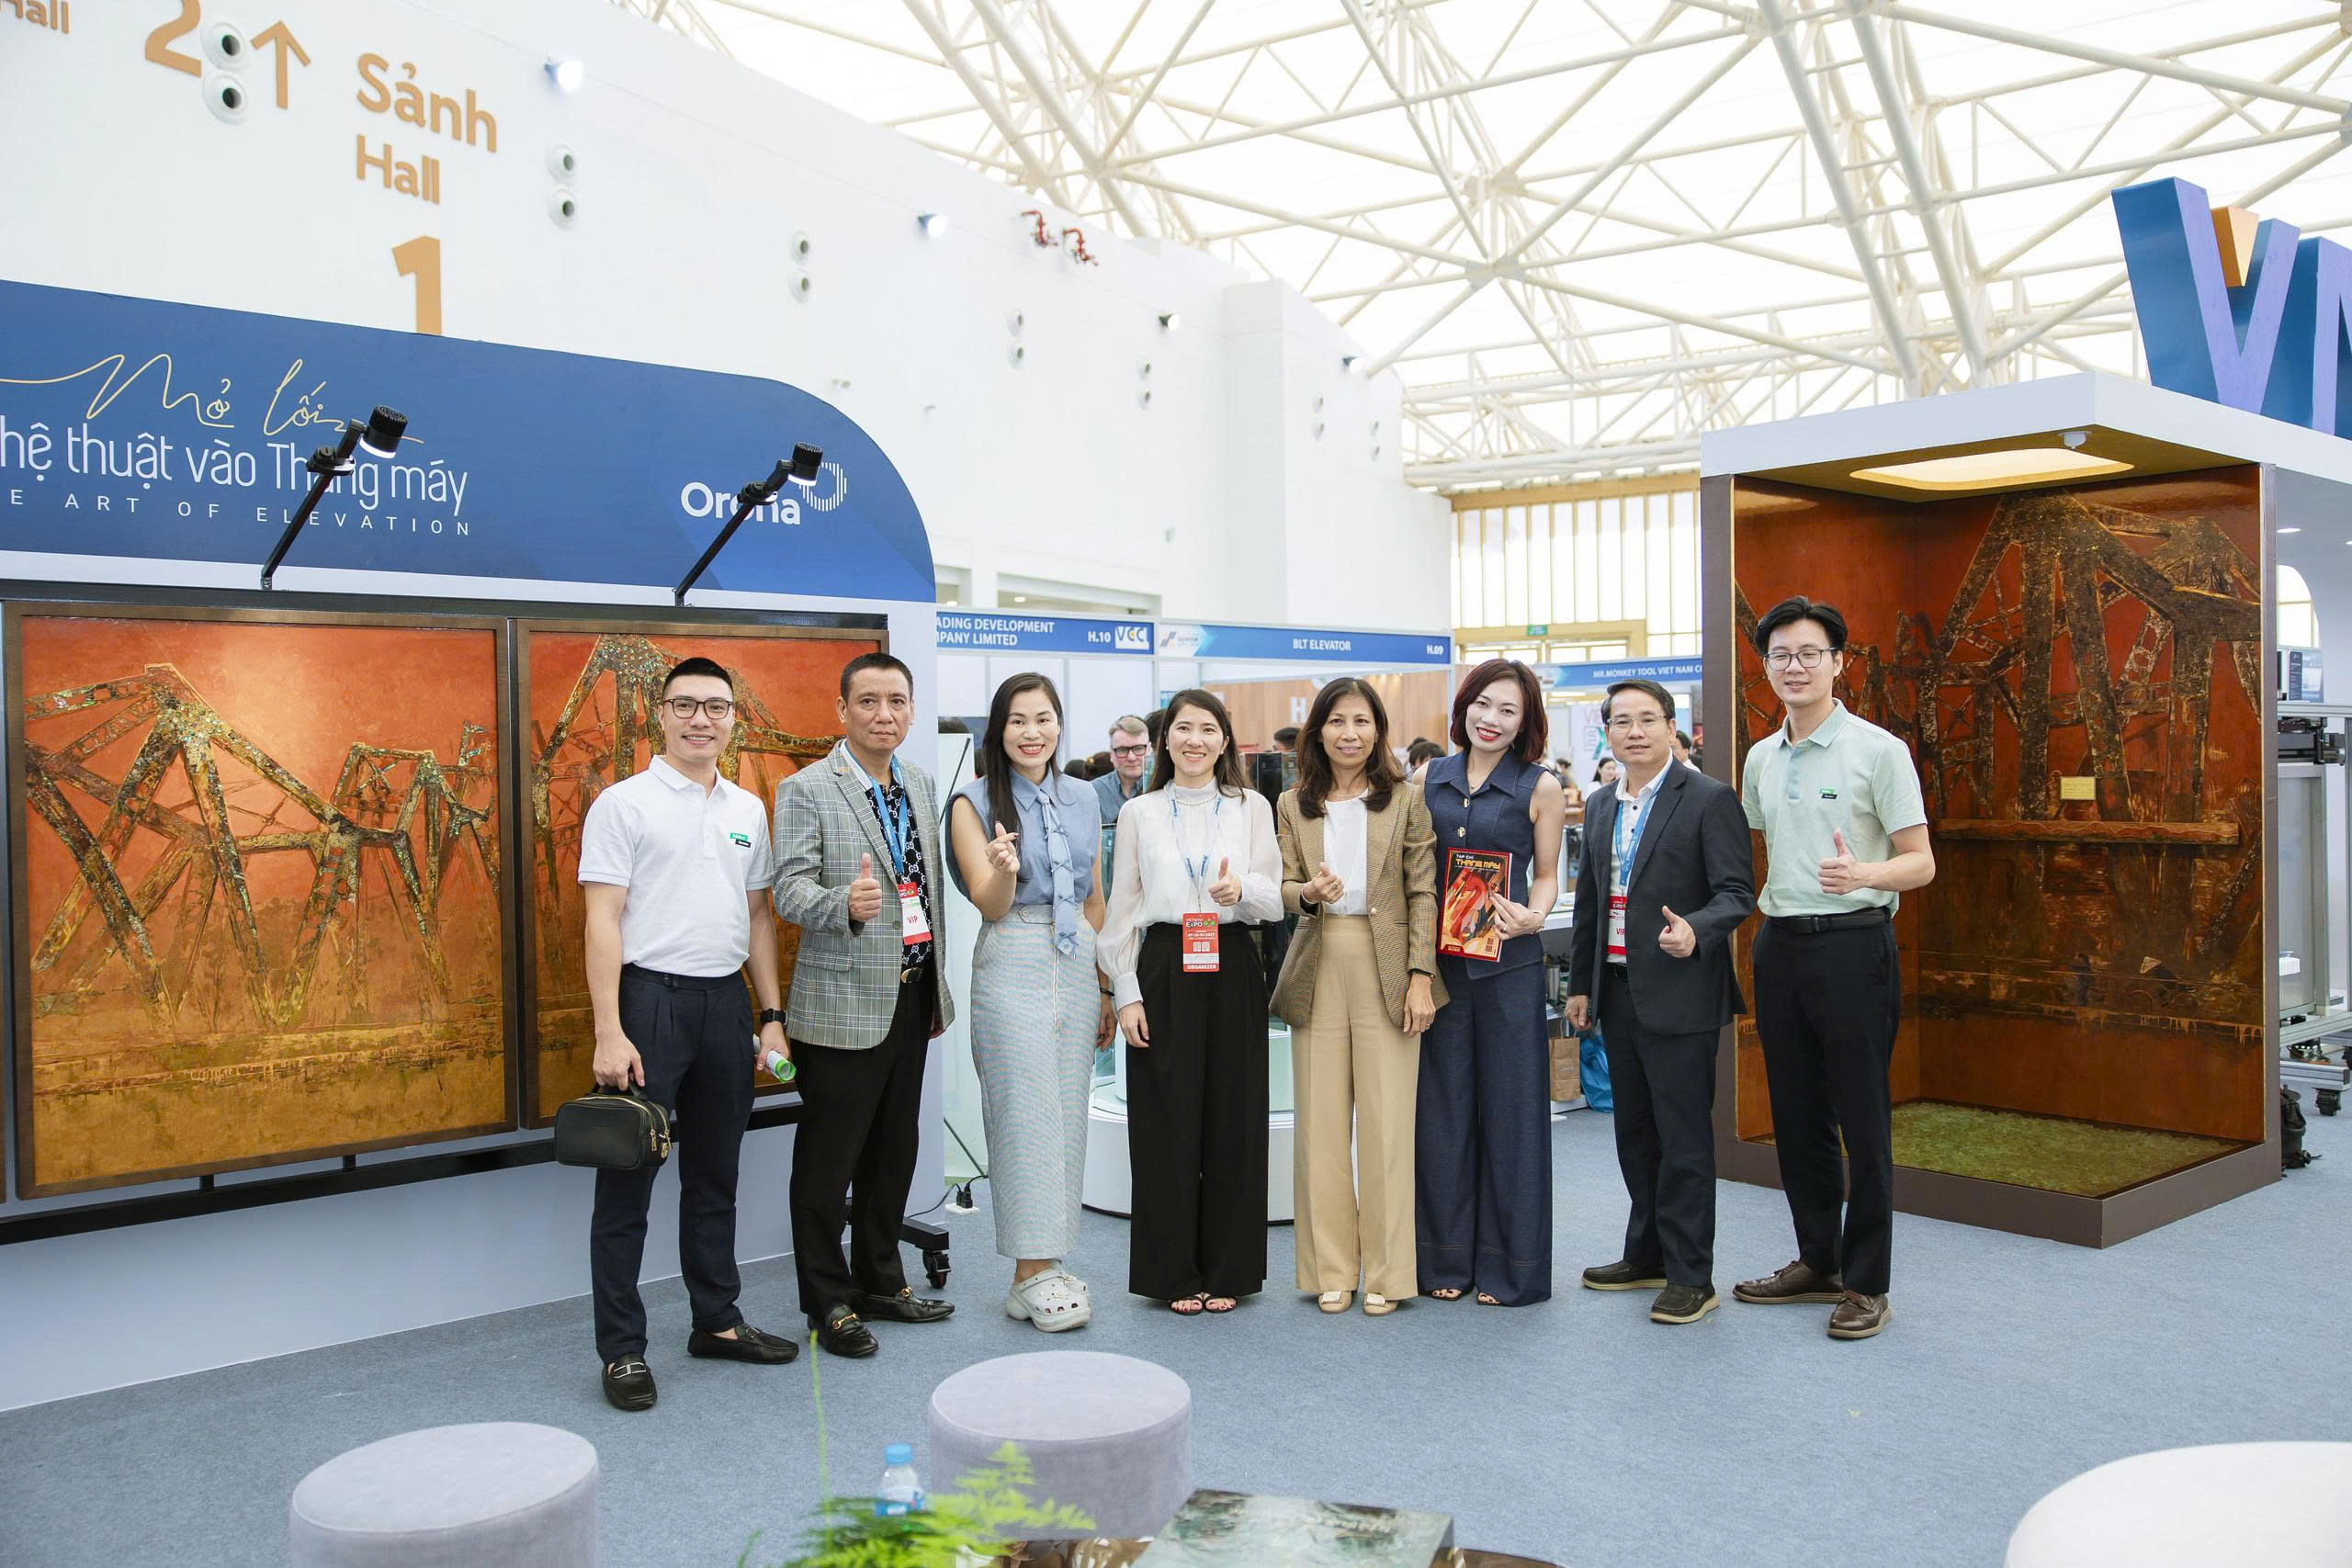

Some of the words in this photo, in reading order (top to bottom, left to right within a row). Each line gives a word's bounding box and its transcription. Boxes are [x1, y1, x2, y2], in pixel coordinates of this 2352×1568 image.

[145, 0, 201, 76] 2
[357, 52, 497, 152] Sảnh
[356, 134, 440, 204] Hall
[392, 235, 441, 334] 1
[0, 415, 51, 481] hệ
[67, 423, 173, 490] thuật
[186, 439, 256, 487] vào
[391, 459, 468, 516] máy
[64, 493, 139, 513] ART
[178, 502, 220, 519] OF
[256, 507, 469, 536] ELEVATION
[973, 633, 1018, 646] LIMITED
[975, 618, 1055, 633] DEVELOPMENT
[1088, 631, 1111, 643] H.10
[1293, 638, 1307, 649] BLT
[1309, 639, 1351, 651] ELEVATOR
[1638, 667, 1657, 676] TOOL
[907, 915, 919, 924] VIP
